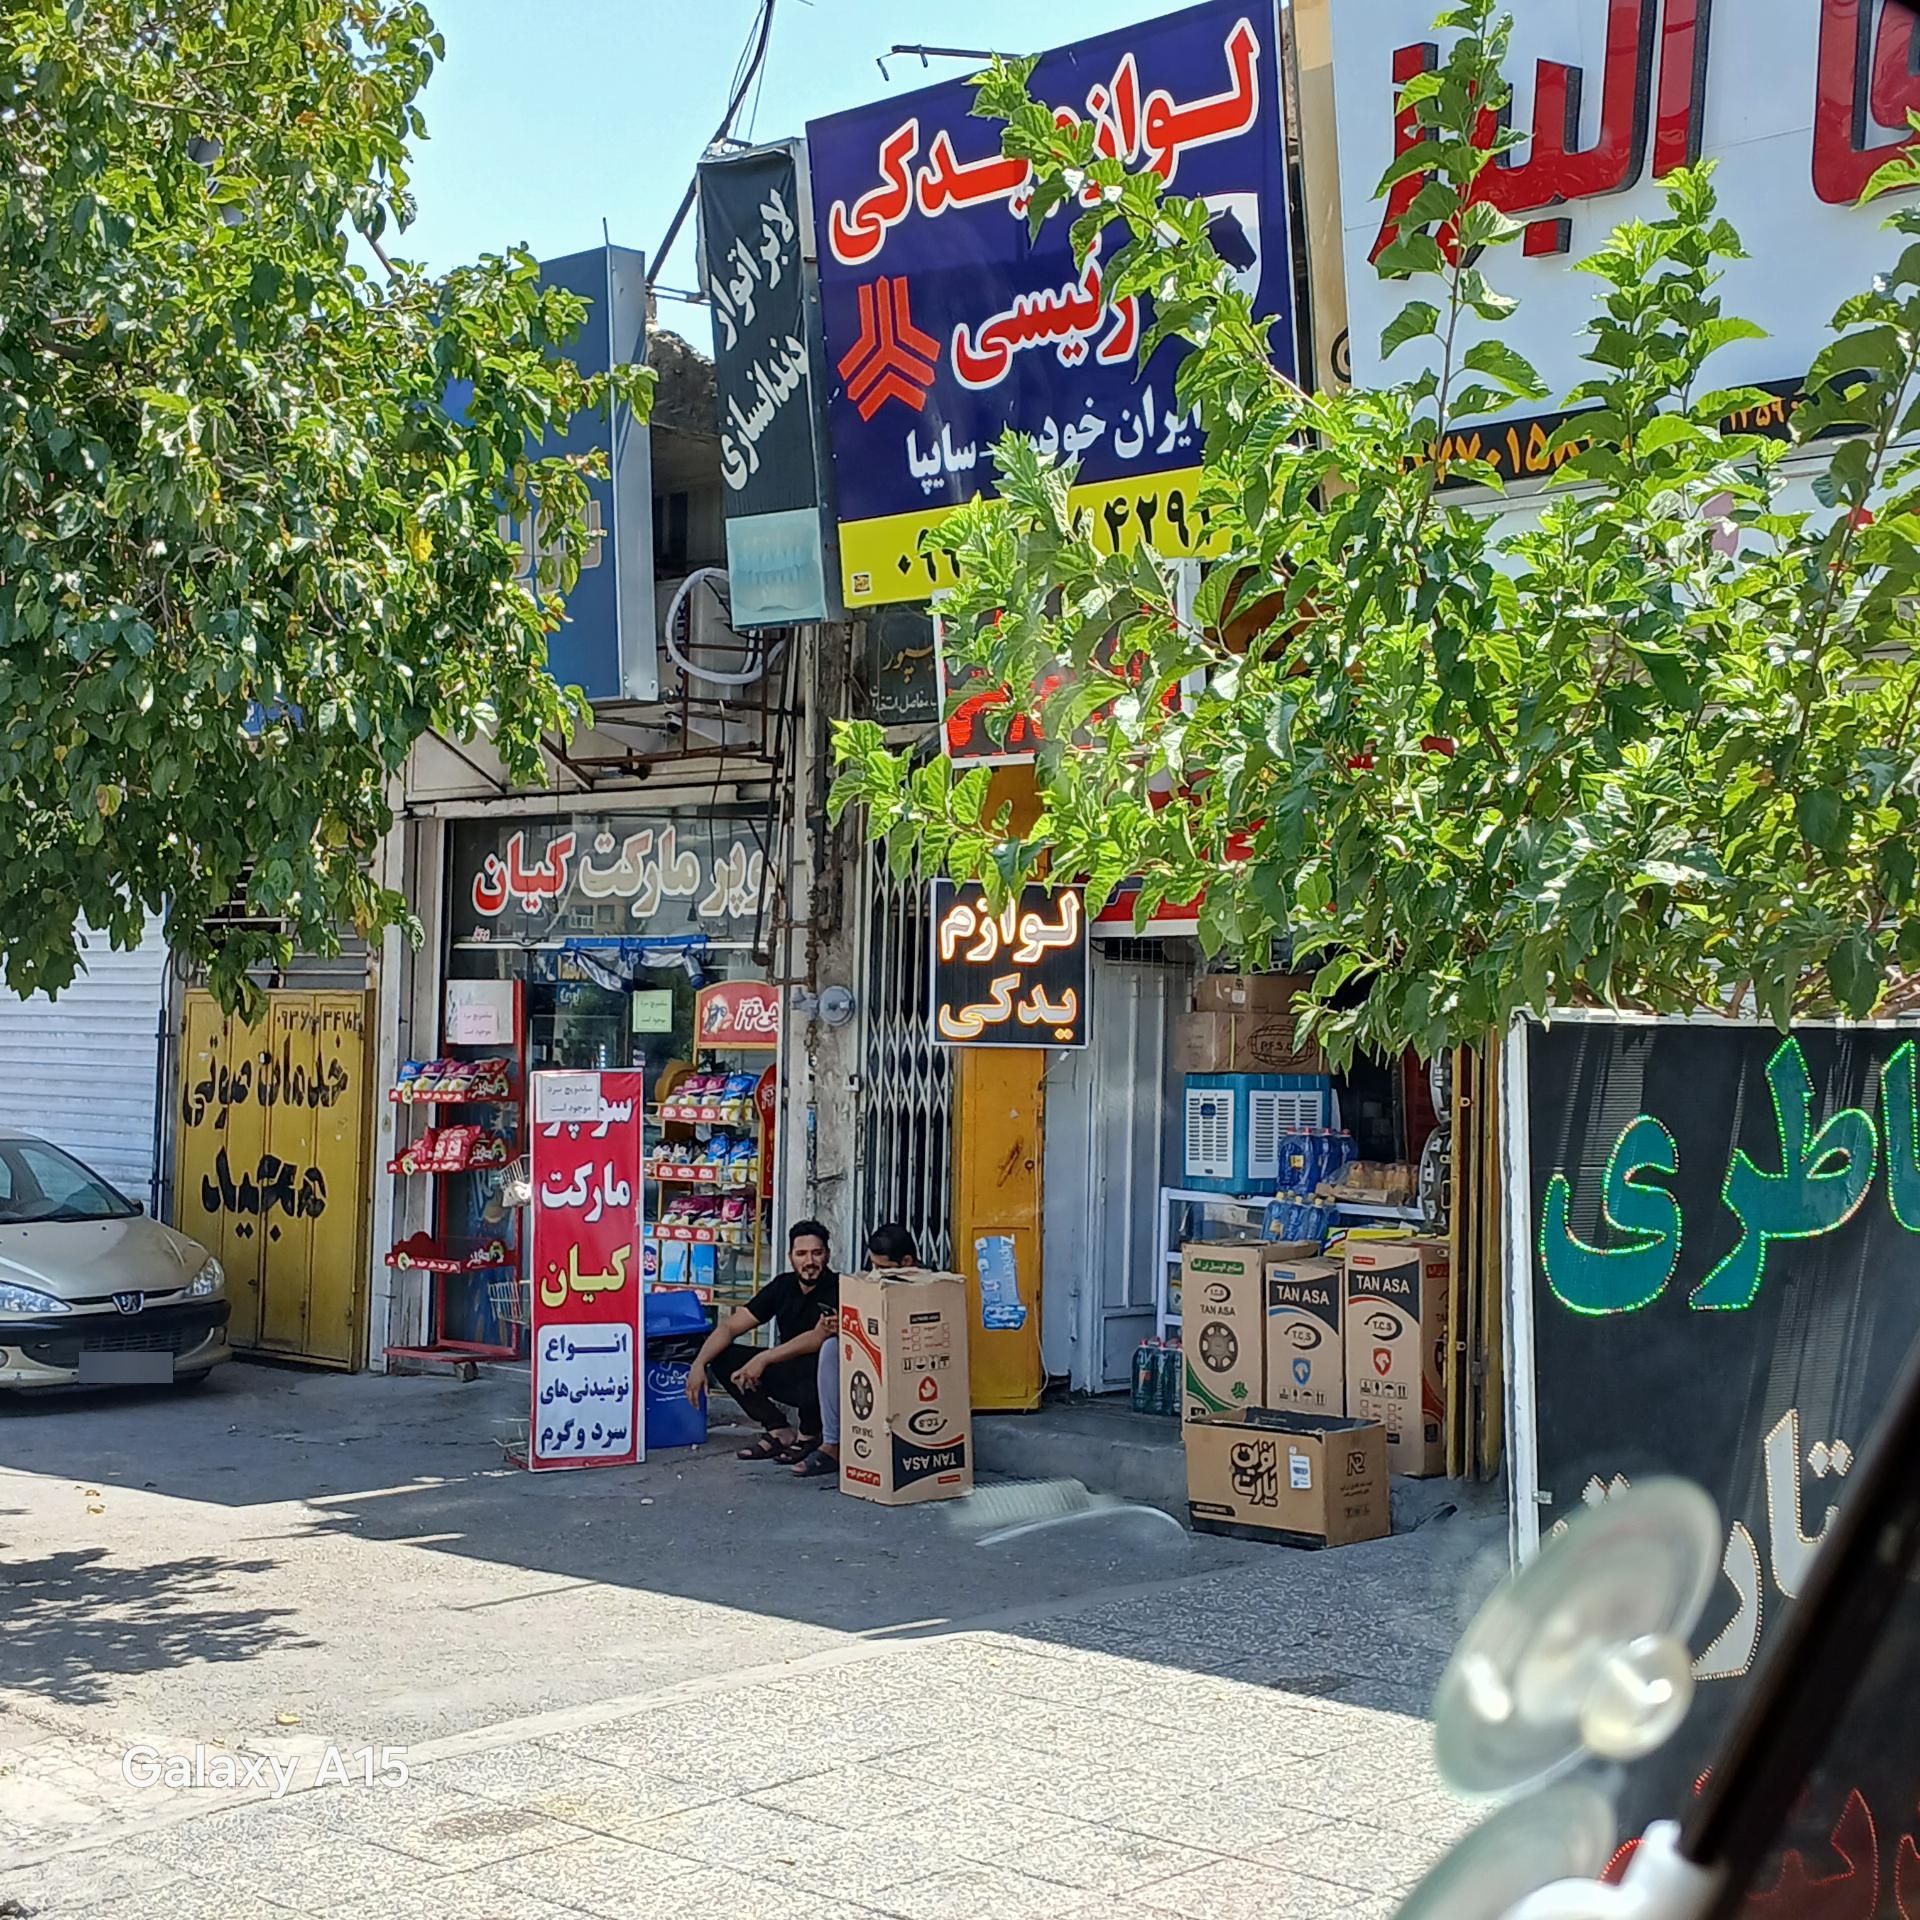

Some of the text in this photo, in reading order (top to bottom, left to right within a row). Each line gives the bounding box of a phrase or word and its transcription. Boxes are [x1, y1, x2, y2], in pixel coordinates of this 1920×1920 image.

[906, 422, 977, 496] سایپا
[472, 831, 577, 917] کیان
[579, 825, 700, 918] مارکت
[939, 889, 1081, 965] لوازم
[938, 973, 1079, 1041] یدکی
[202, 1146, 326, 1242] مجید
[540, 1161, 631, 1223] مارکت
[540, 1243, 632, 1308] کیان
[1276, 1285, 1330, 1306] TAN ASA
[1356, 1274, 1411, 1294] TAN ASA
[545, 1333, 627, 1362] انواع
[540, 1418, 627, 1454] سرد و گرم
[902, 1452, 957, 1471] TAN ASA
